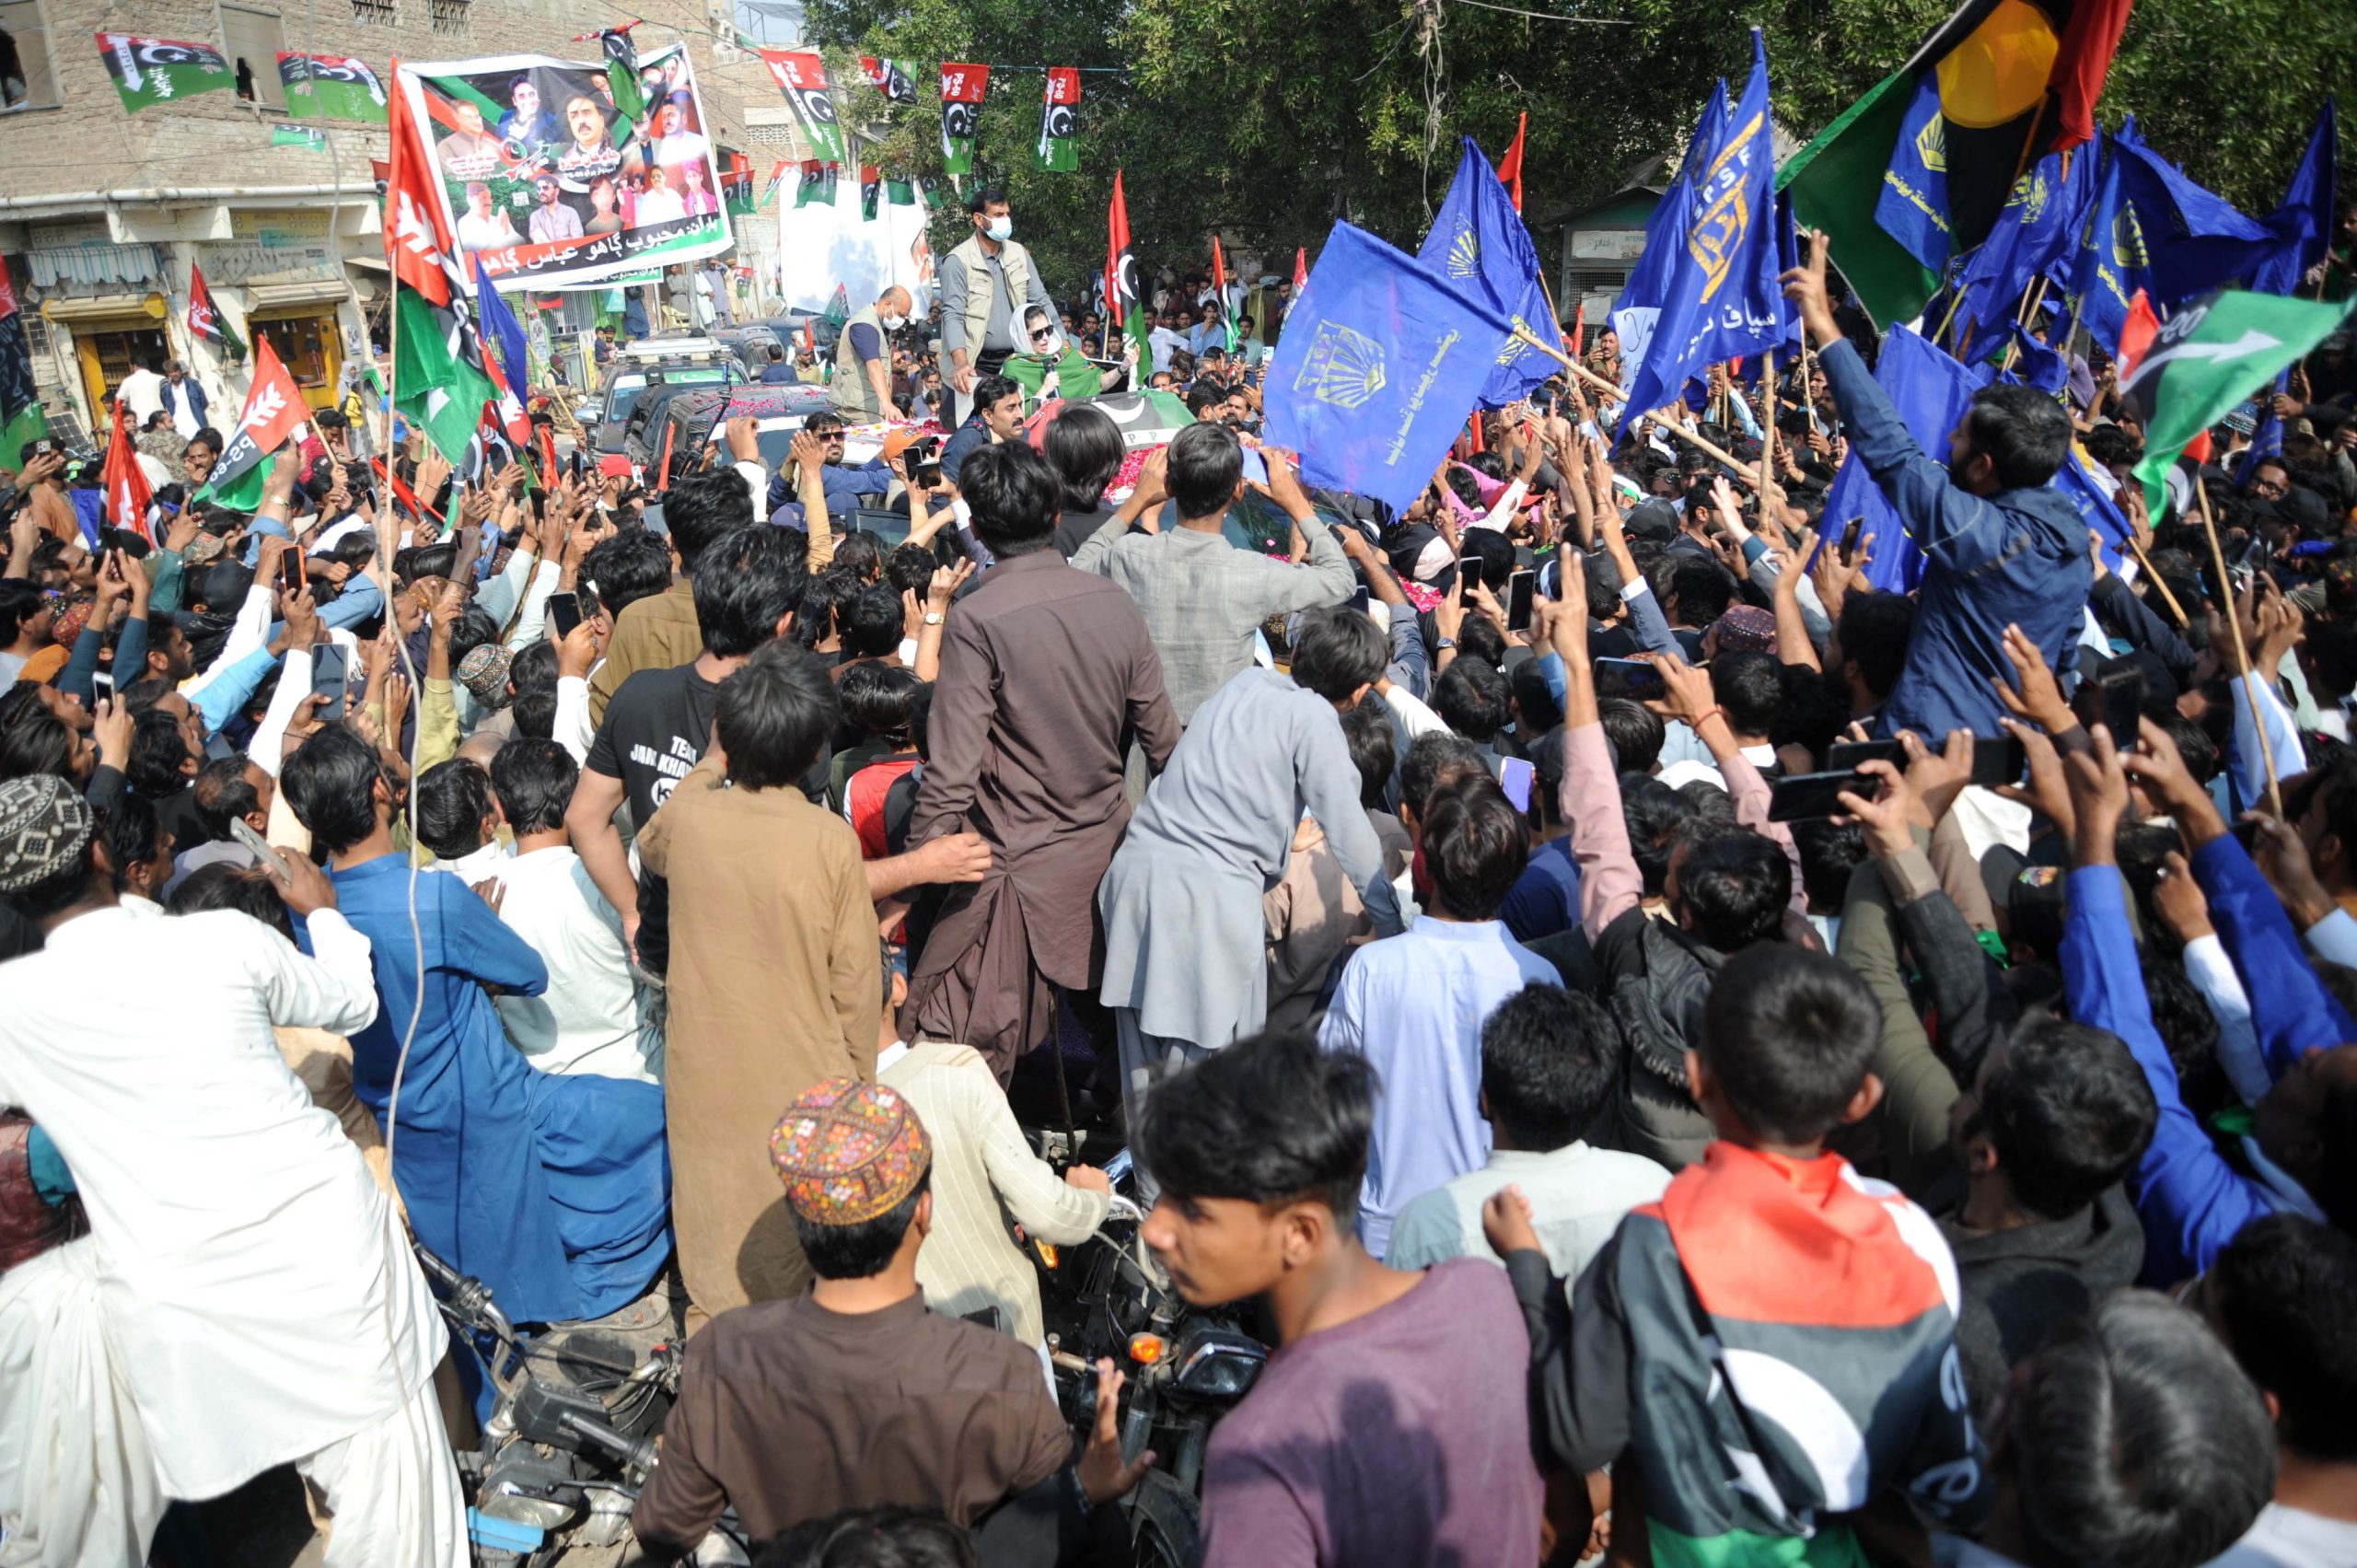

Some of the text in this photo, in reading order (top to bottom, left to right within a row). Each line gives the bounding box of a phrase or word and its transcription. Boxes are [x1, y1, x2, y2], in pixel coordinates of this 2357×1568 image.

[951, 73, 965, 97] PS-60
[626, 228, 686, 251] محبوب
[527, 246, 578, 269] عباس
[1722, 297, 1776, 339] سپاف
